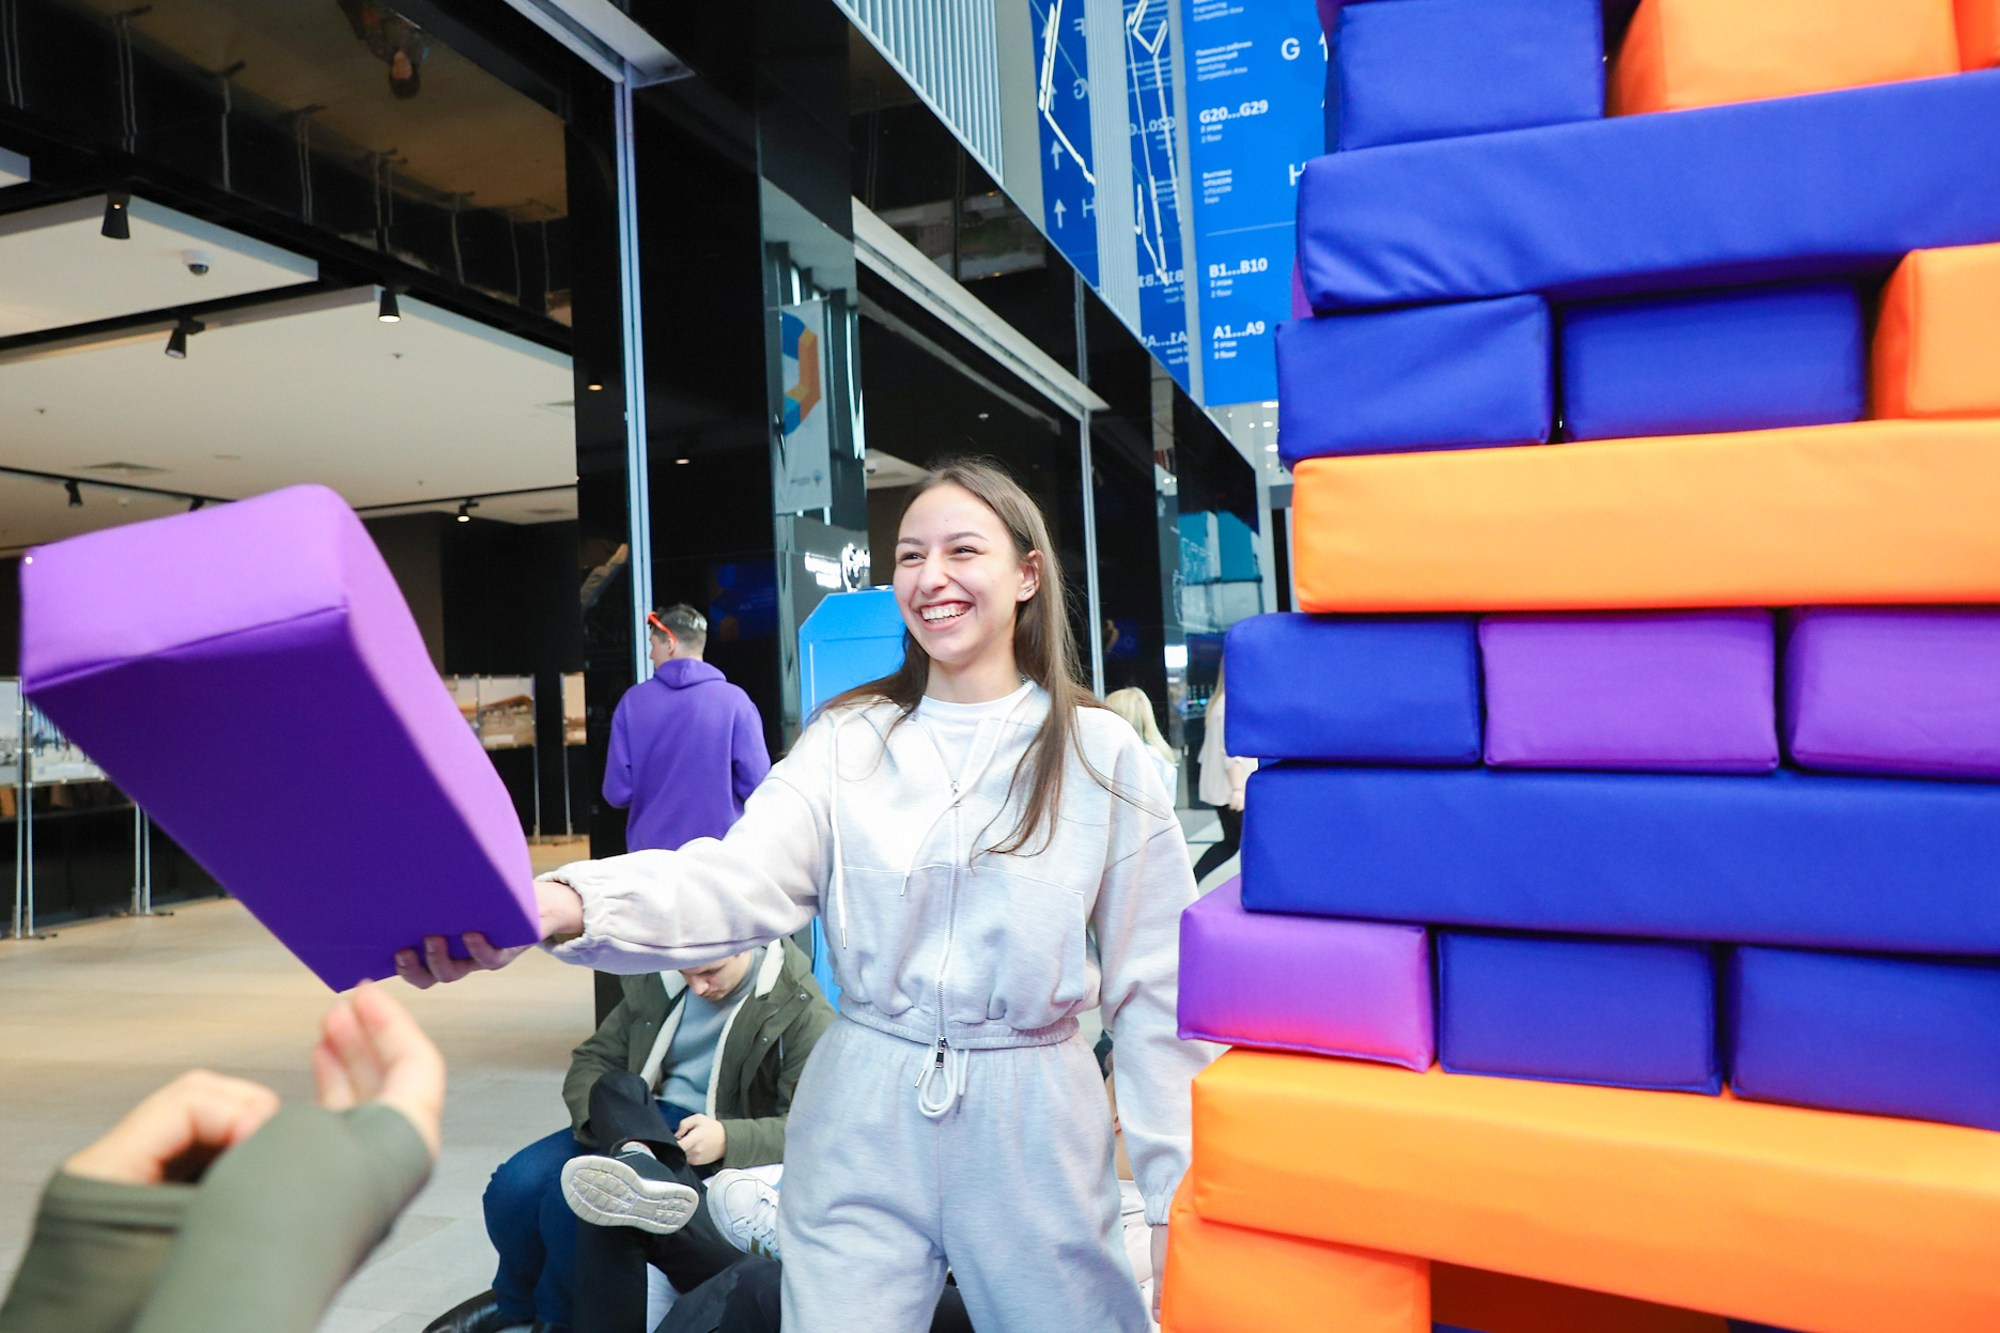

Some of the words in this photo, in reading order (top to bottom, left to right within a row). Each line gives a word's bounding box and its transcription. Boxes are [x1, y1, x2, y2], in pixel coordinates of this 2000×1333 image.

[1281, 37, 1300, 61] G
[1199, 99, 1269, 124] G20...G29
[1209, 257, 1268, 278] B1...B10
[1213, 321, 1265, 339] A1...A9
